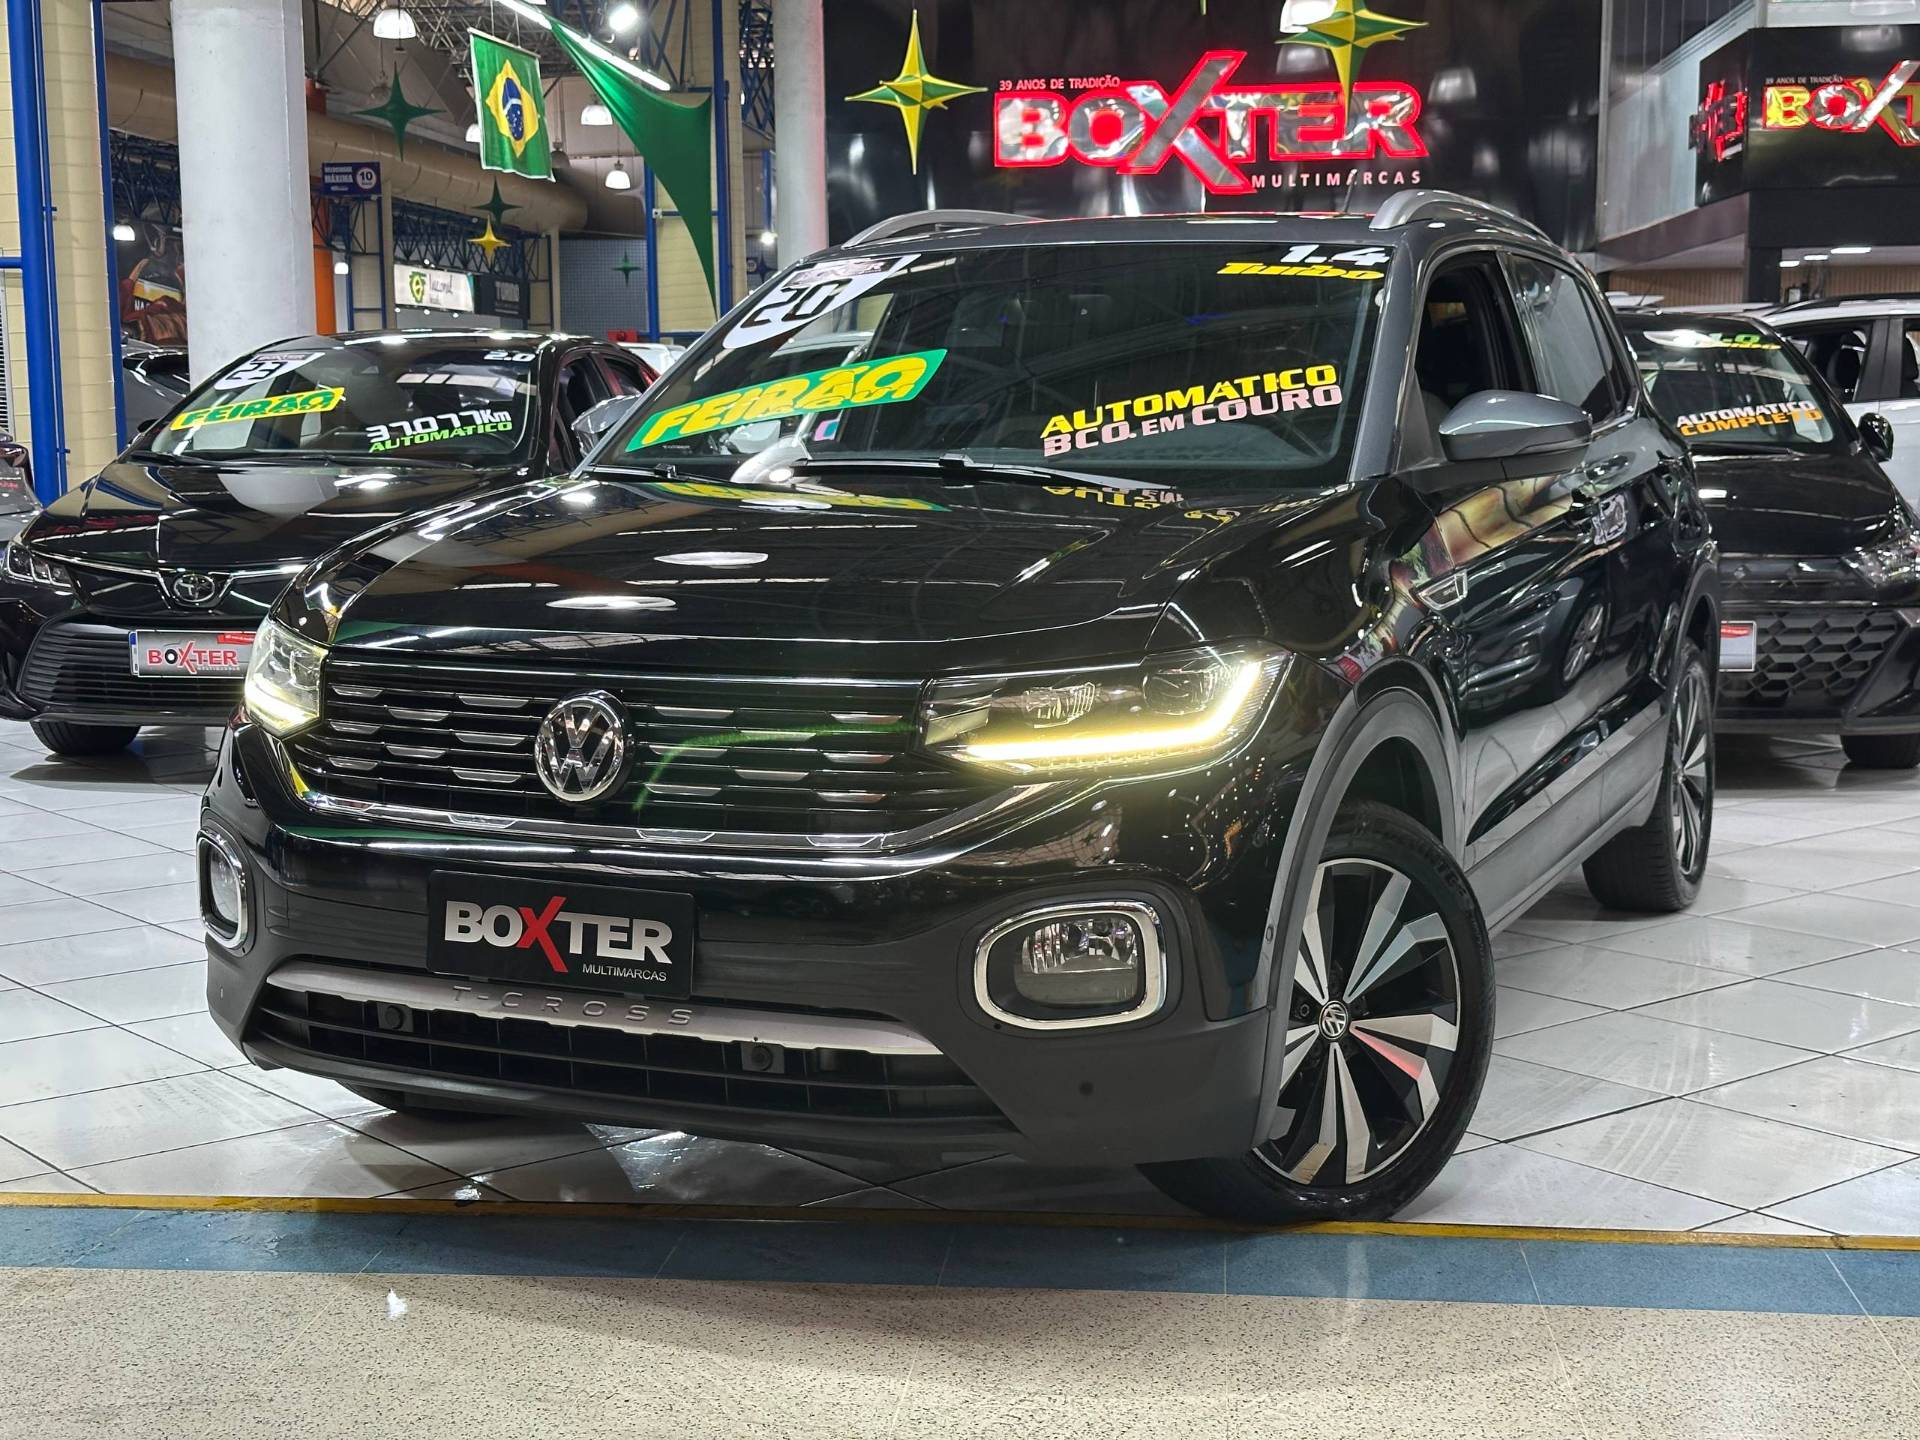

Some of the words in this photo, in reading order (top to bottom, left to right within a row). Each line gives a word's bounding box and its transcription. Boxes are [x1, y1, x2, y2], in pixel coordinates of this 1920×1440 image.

[999, 80, 1012, 91] 39
[1016, 78, 1046, 90] ANOS
[1050, 78, 1065, 89] DE
[1069, 75, 1120, 90] TRADIÇÃO
[994, 50, 1429, 194] BOXTER
[360, 171, 373, 181] 10
[1280, 244, 1391, 266] 1.4
[740, 278, 853, 328] 20
[483, 351, 536, 362] 2.0
[1142, 412, 1185, 436] EM
[1191, 384, 1343, 427] COURO
[1678, 409, 1823, 437] COMPLETO
[146, 640, 240, 675] BOXTER
[444, 896, 673, 973] BOXTER
[582, 963, 667, 982] MULTIMARCAS
[452, 985, 693, 1026] T-CROSS
